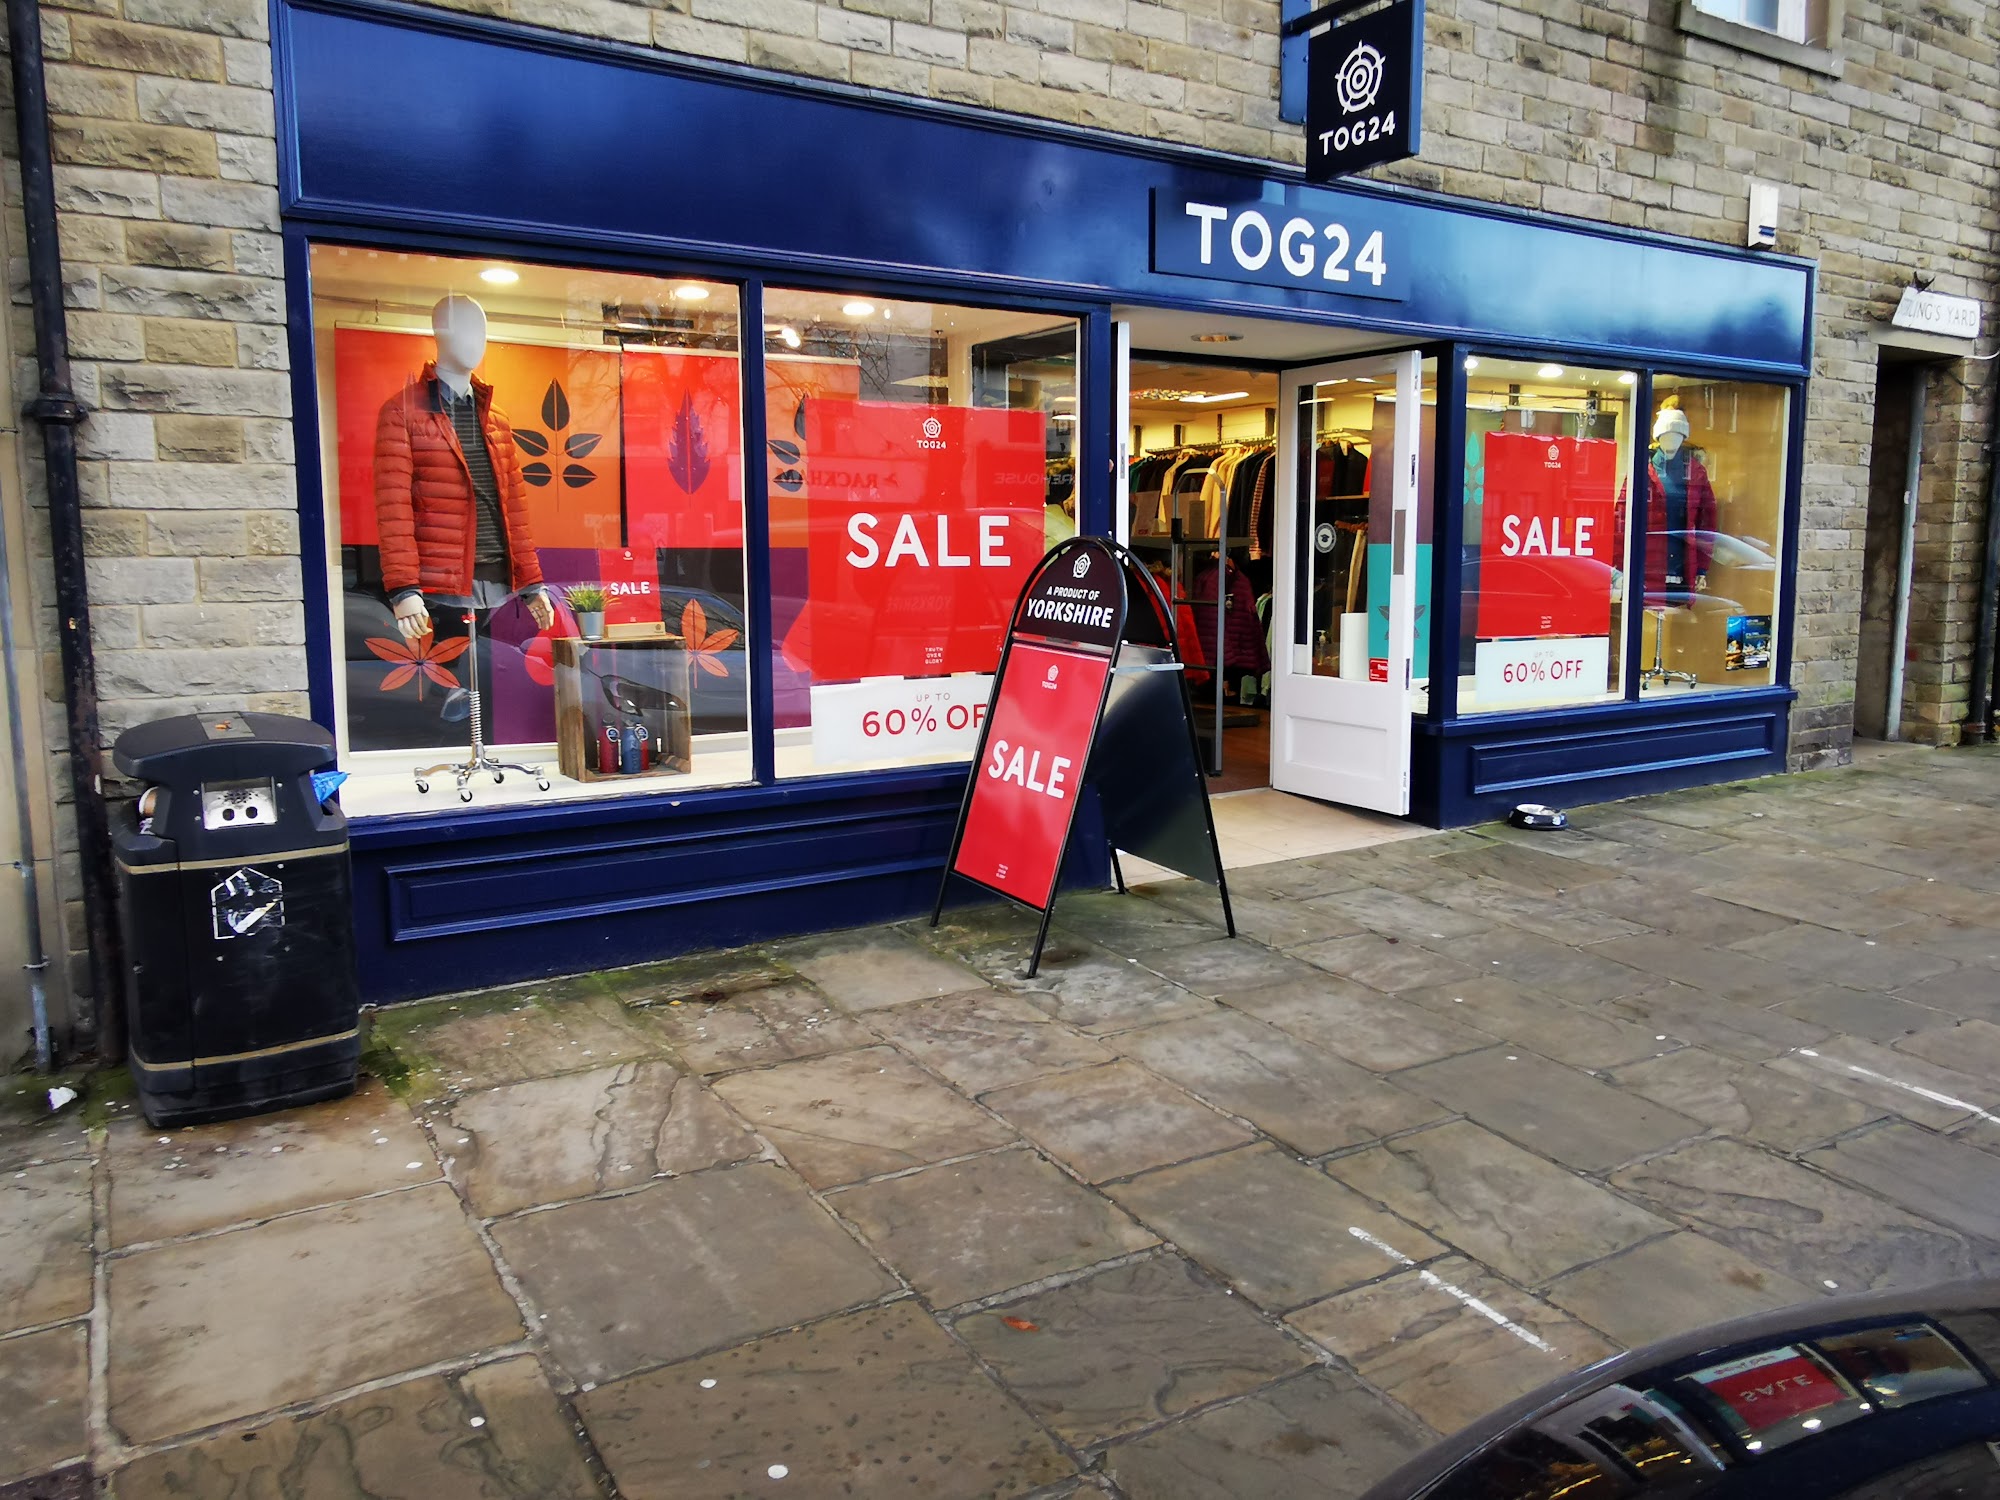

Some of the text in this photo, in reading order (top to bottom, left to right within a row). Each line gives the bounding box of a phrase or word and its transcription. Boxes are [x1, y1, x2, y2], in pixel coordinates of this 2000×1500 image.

[1319, 111, 1396, 156] TOG24
[1185, 202, 1387, 287] TOG24
[1947, 304, 1977, 327] YARD
[917, 439, 947, 449] TOG24
[845, 512, 1012, 569] SALE
[1500, 514, 1595, 557] SALE
[610, 581, 651, 596] SALE
[1046, 586, 1101, 601] A PRODUCT OF
[1026, 598, 1115, 629] YORKSHIRE
[1503, 659, 1584, 684] 60% OFF
[916, 692, 951, 702] UP TO
[861, 703, 988, 738] 60% OF
[987, 739, 1073, 800] SALE
